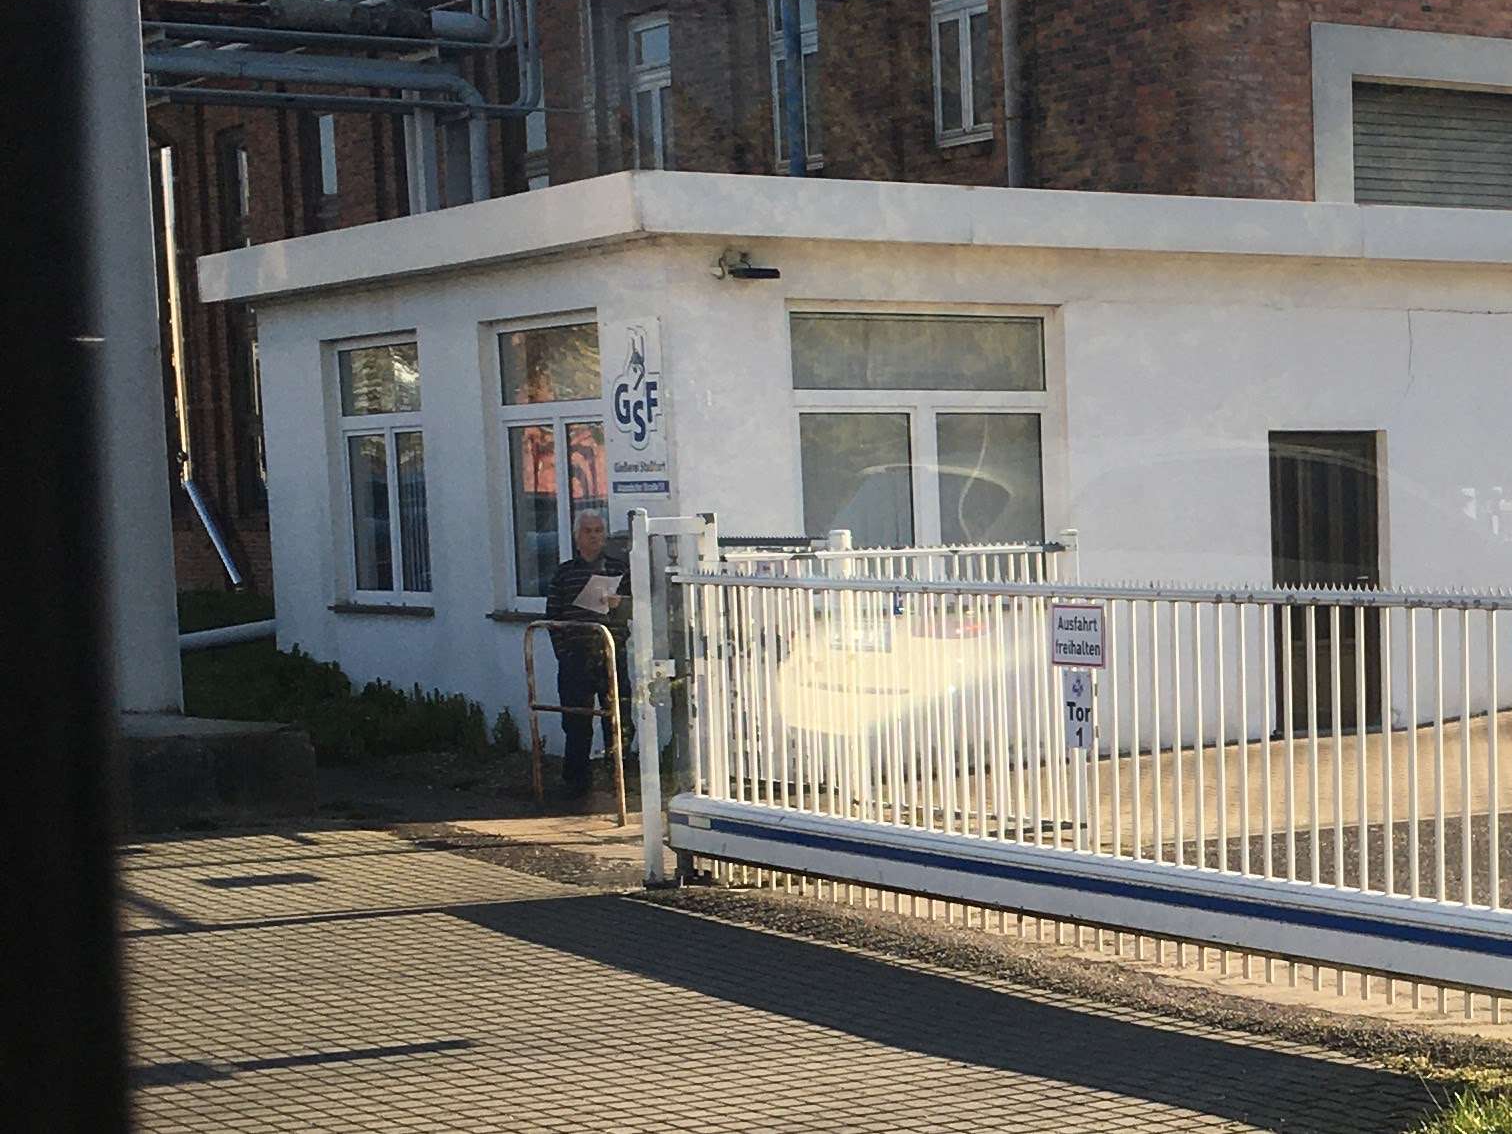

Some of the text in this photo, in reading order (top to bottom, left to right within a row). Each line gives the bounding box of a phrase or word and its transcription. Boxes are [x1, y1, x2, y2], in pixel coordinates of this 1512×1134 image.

[614, 381, 658, 442] GSF
[1057, 615, 1098, 632] Ausfahrt
[1055, 639, 1101, 656] freihalten
[1066, 701, 1091, 723] Tor
[1075, 726, 1083, 747] 1
